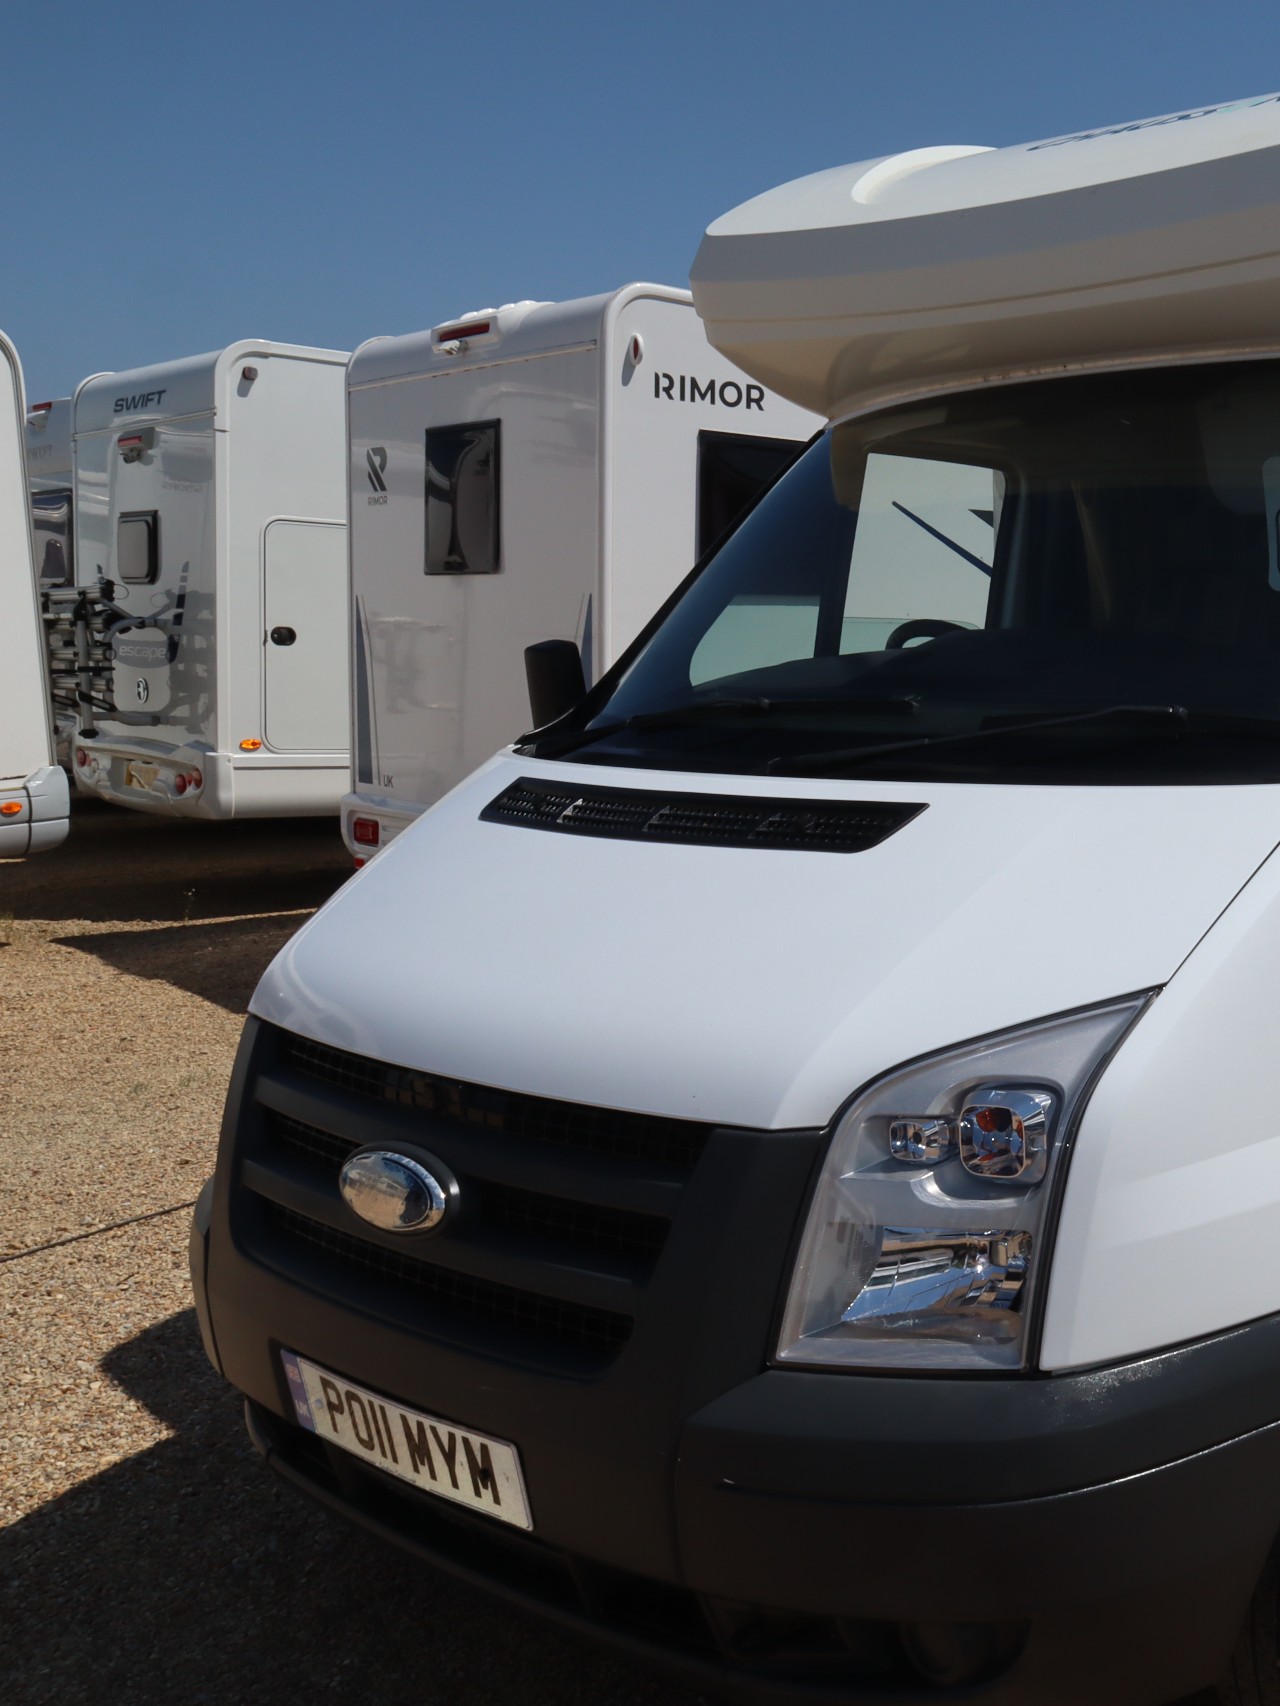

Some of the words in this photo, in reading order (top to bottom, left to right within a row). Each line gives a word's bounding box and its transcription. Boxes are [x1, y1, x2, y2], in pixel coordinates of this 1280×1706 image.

[113, 389, 167, 413] SWIFT
[654, 371, 765, 412] RIMOR
[367, 495, 388, 506] RIMOR
[119, 645, 167, 662] escape
[383, 774, 394, 789] UK
[399, 1412, 502, 1507] MYM
